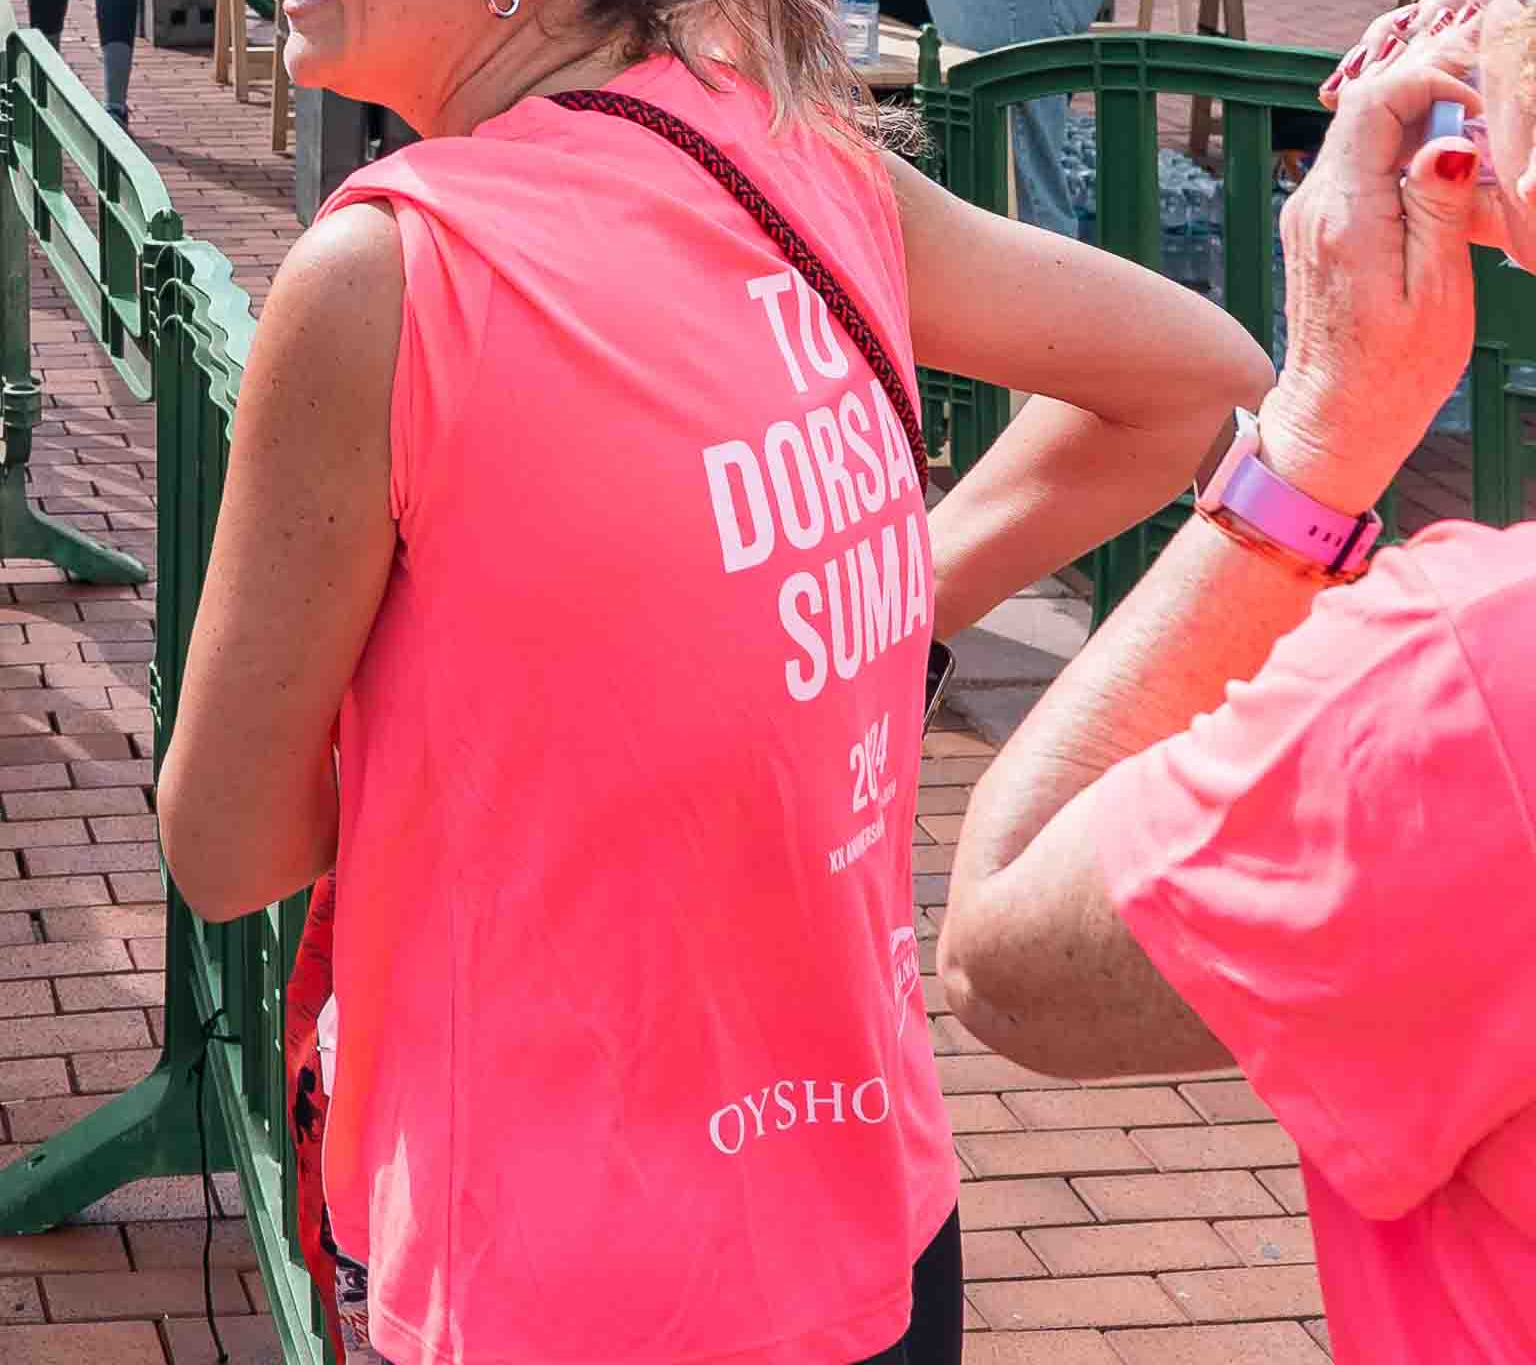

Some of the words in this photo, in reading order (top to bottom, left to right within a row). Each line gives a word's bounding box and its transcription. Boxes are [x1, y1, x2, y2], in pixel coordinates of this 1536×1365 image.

[745, 269, 849, 393] TU
[776, 511, 929, 702] SUMA
[709, 1077, 891, 1156] OYSHO
